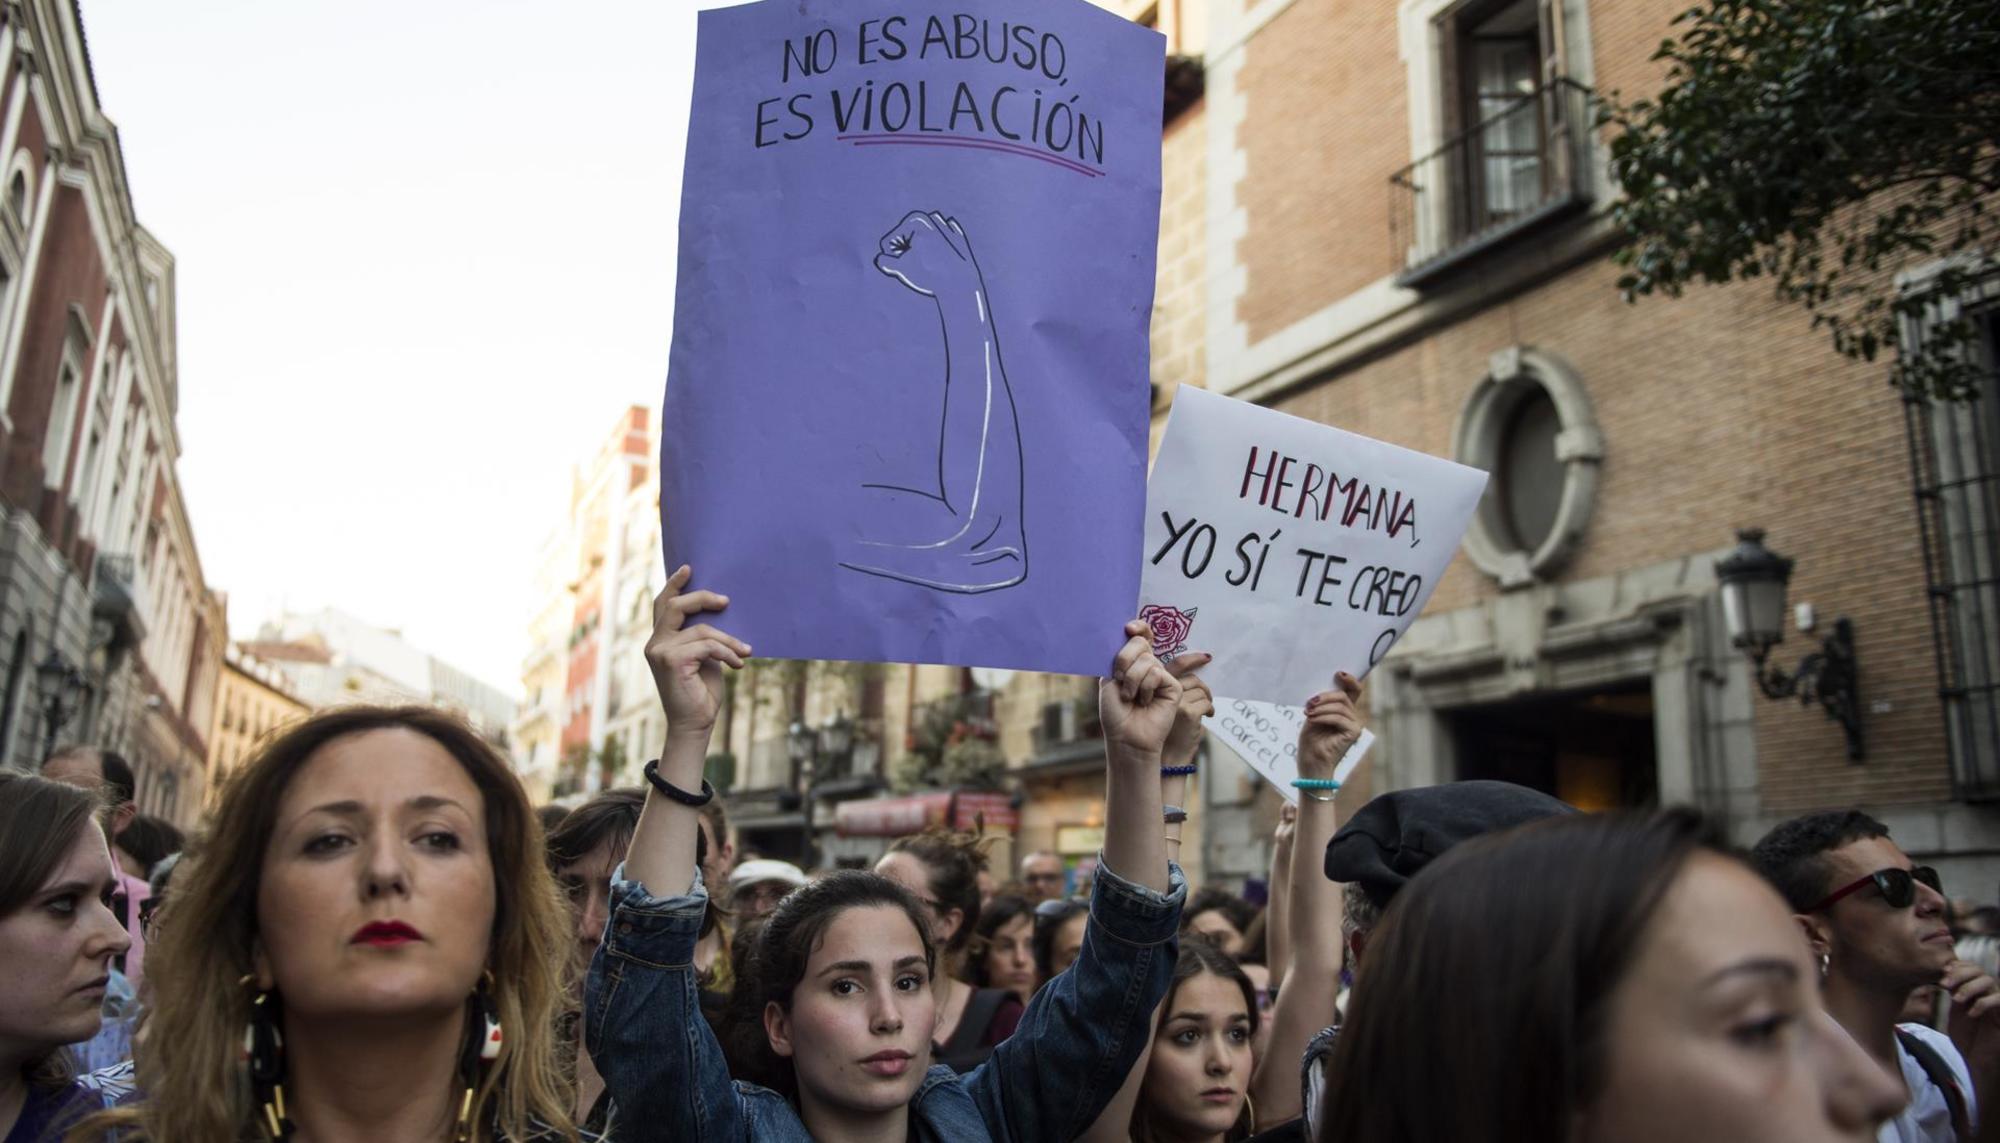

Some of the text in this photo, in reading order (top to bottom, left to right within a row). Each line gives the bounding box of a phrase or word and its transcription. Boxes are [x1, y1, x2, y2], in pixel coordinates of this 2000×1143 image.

[782, 13, 1068, 86] NO ES ABUSO,
[755, 93, 813, 148] ES
[1239, 446, 1421, 549] HERMANA,
[1151, 511, 1422, 617] YO SÍ TE CREO
